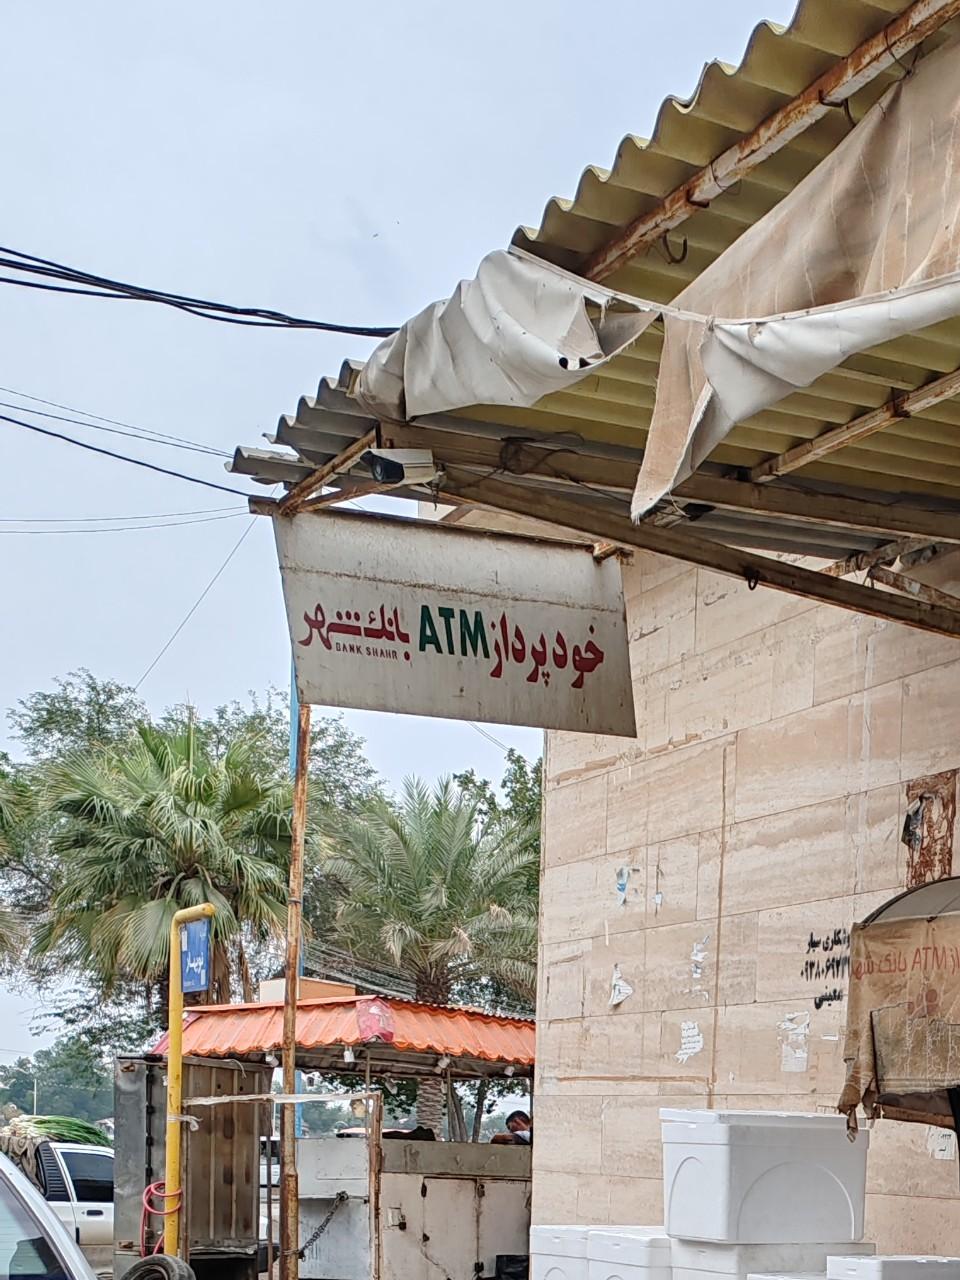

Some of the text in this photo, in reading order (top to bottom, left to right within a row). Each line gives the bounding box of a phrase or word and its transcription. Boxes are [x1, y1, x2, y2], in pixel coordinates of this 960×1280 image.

[299, 602, 362, 651] شهر
[418, 604, 490, 659] ATM
[335, 641, 399, 661] BANK SHAHR
[911, 945, 947, 971] ATM
